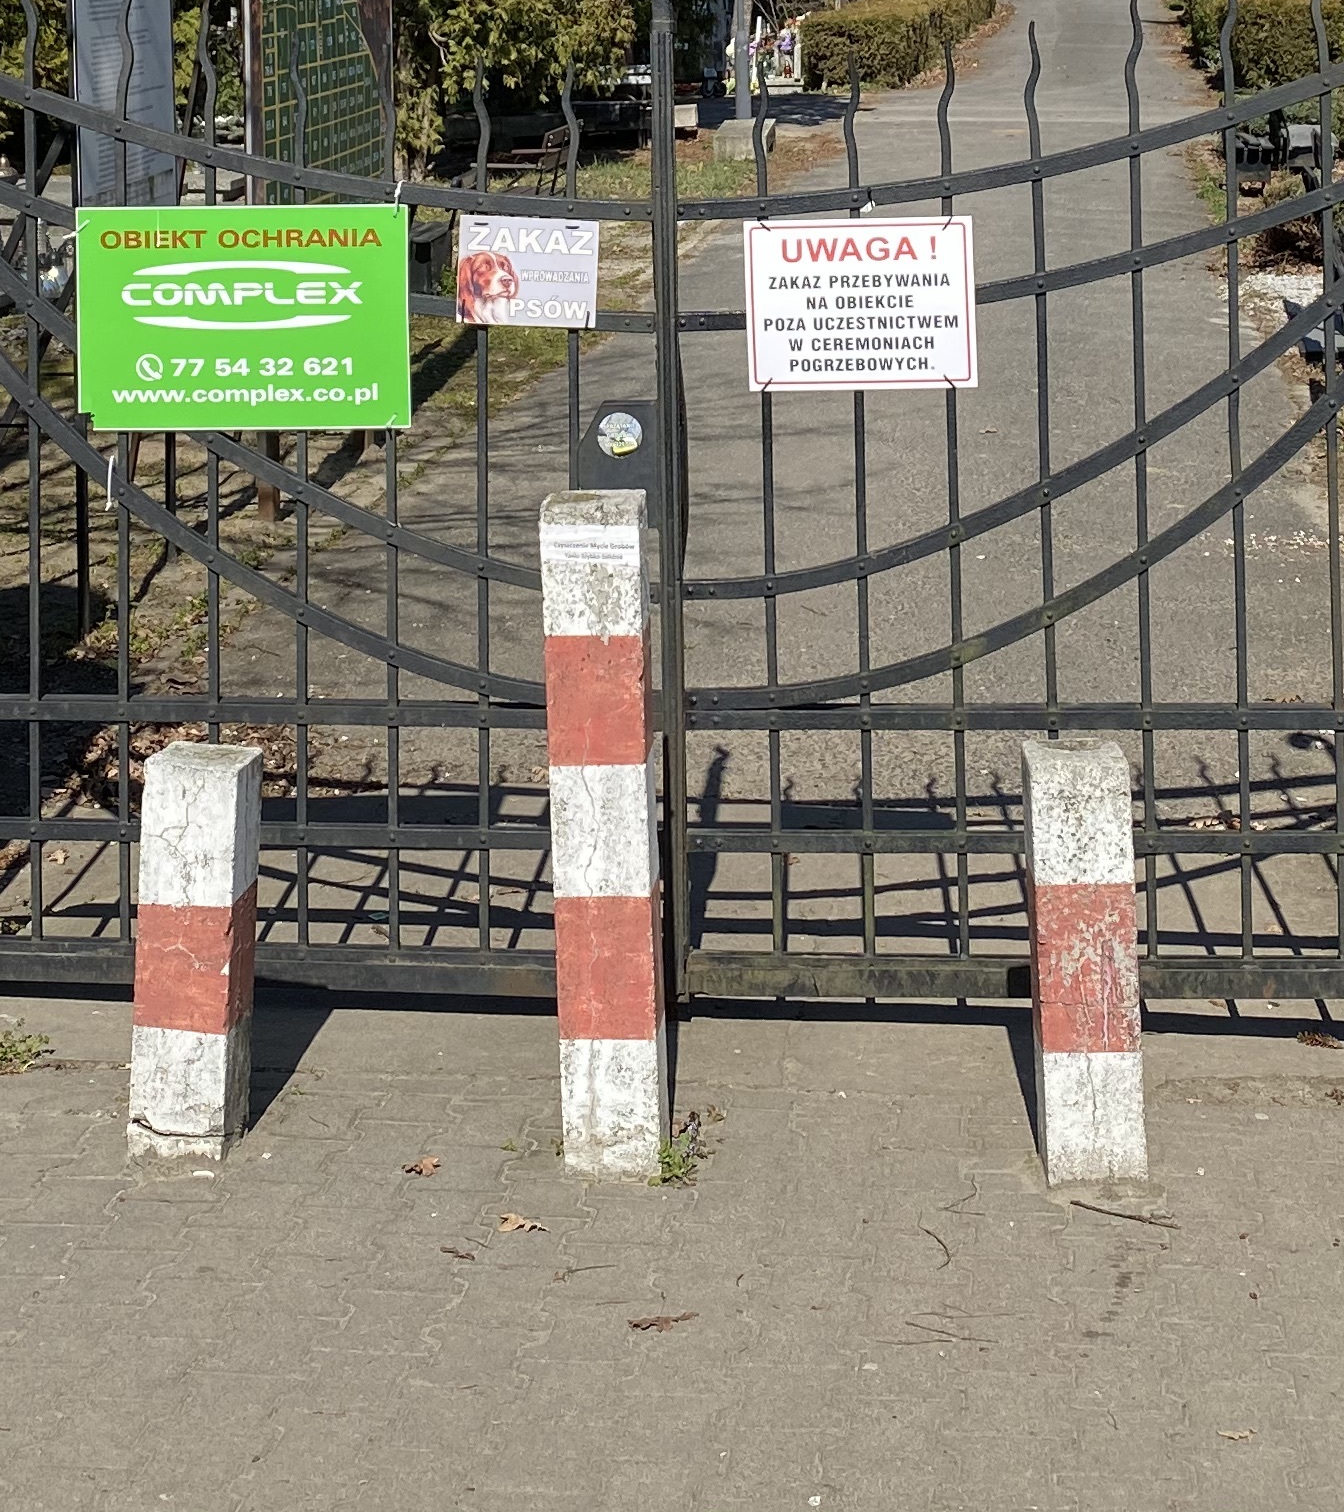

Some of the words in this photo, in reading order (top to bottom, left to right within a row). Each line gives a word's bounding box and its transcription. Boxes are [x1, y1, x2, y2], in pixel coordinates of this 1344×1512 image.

[99, 229, 208, 250] OBIEKT
[217, 228, 383, 249] OCHRANIA
[466, 226, 594, 256] ZAKAZ
[781, 236, 918, 263] UWAGA
[520, 269, 590, 284] WPROWADZANIA
[768, 275, 821, 290] ZAKAZ
[829, 273, 951, 289] PRZEBYWANIA
[121, 281, 364, 307] COMPLEX
[806, 296, 828, 310] NA
[835, 295, 914, 310] OBIEKCIE
[508, 295, 587, 320] PSÓW
[764, 318, 806, 331] POZA
[813, 315, 959, 331] UCZESTNICTWEM
[788, 338, 803, 352] W
[811, 336, 935, 351] CEREMONIACH
[170, 358, 205, 378] 77
[214, 358, 251, 377] 54
[259, 357, 294, 377] 32
[303, 357, 353, 376] 621
[789, 357, 935, 372] POGRZEBOWYCH.
[111, 383, 379, 407] www.complex.co.pl
